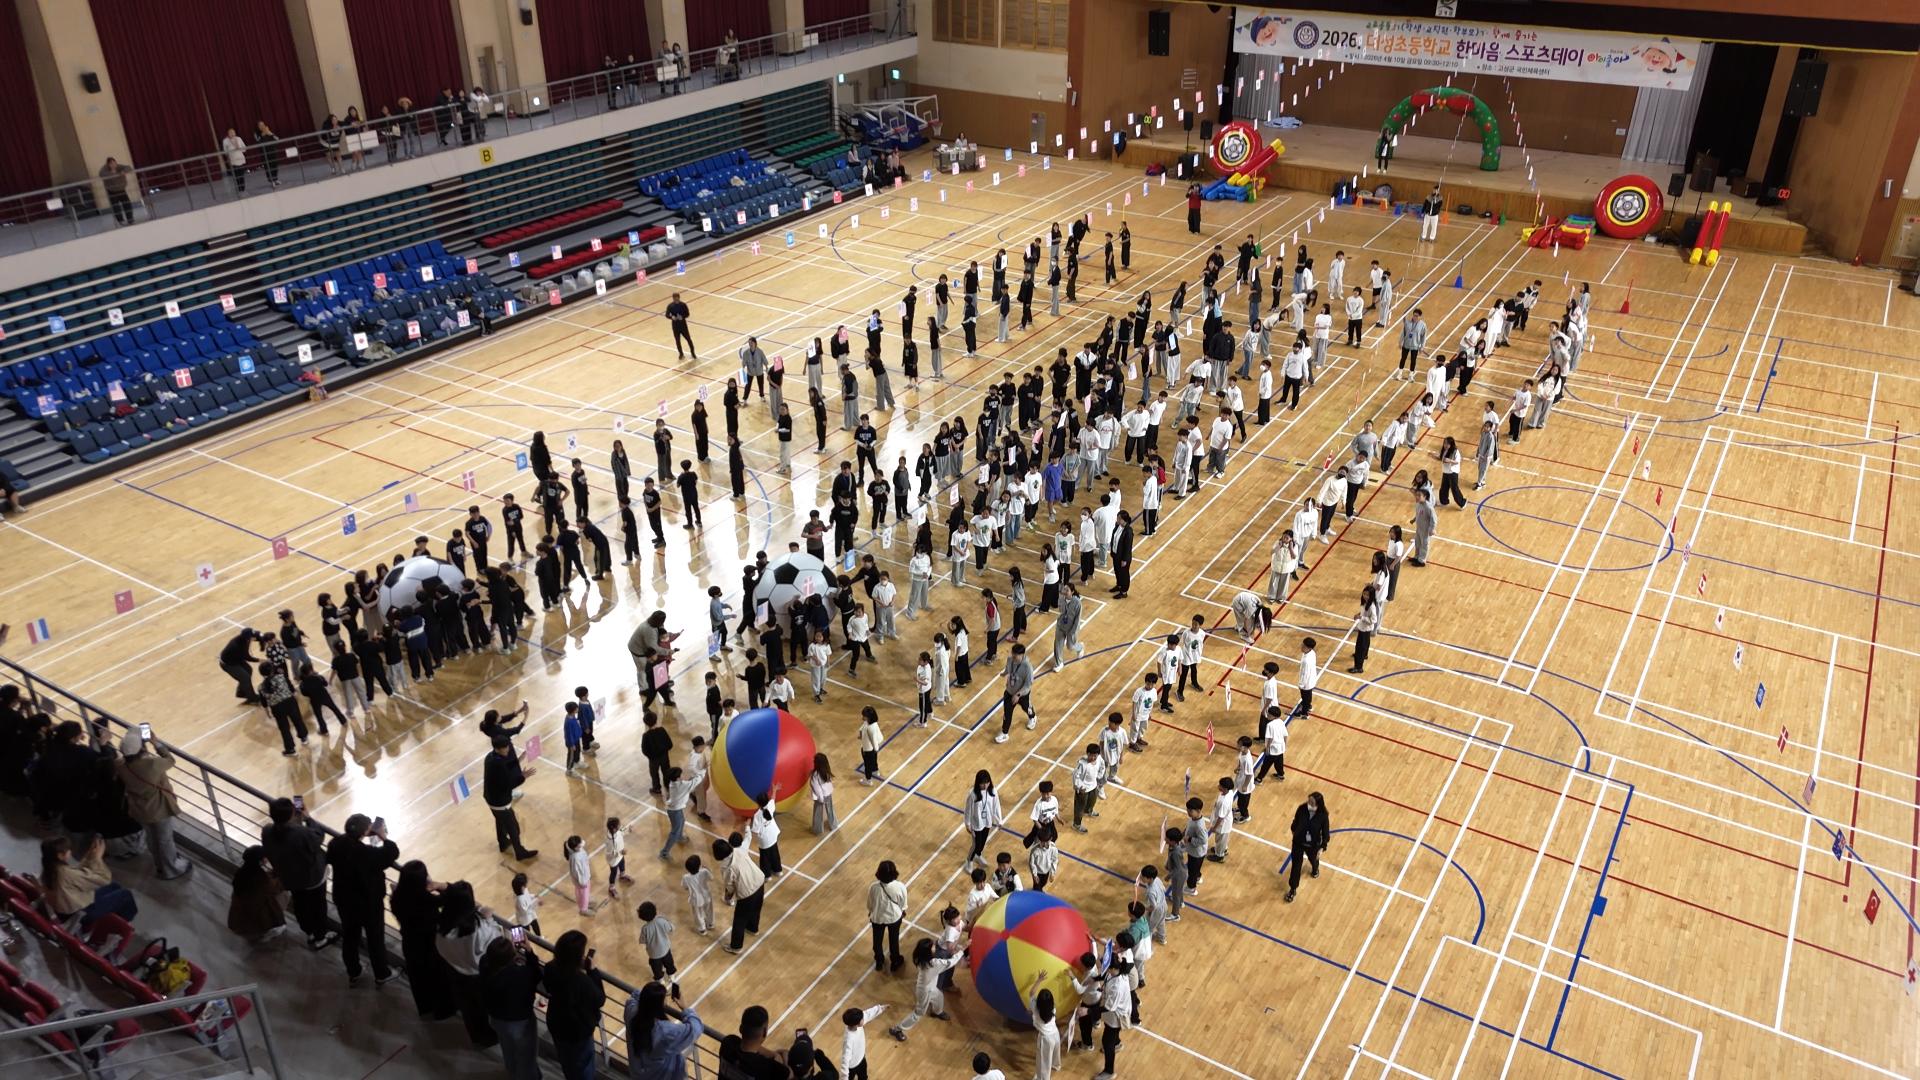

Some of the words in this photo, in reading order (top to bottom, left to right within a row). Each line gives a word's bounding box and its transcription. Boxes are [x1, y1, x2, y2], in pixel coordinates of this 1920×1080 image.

[1365, 33, 1451, 57] 대성초등학교
[1456, 39, 1500, 62] 한마음
[1504, 44, 1584, 67] 스포츠데이
[483, 149, 491, 161] B
